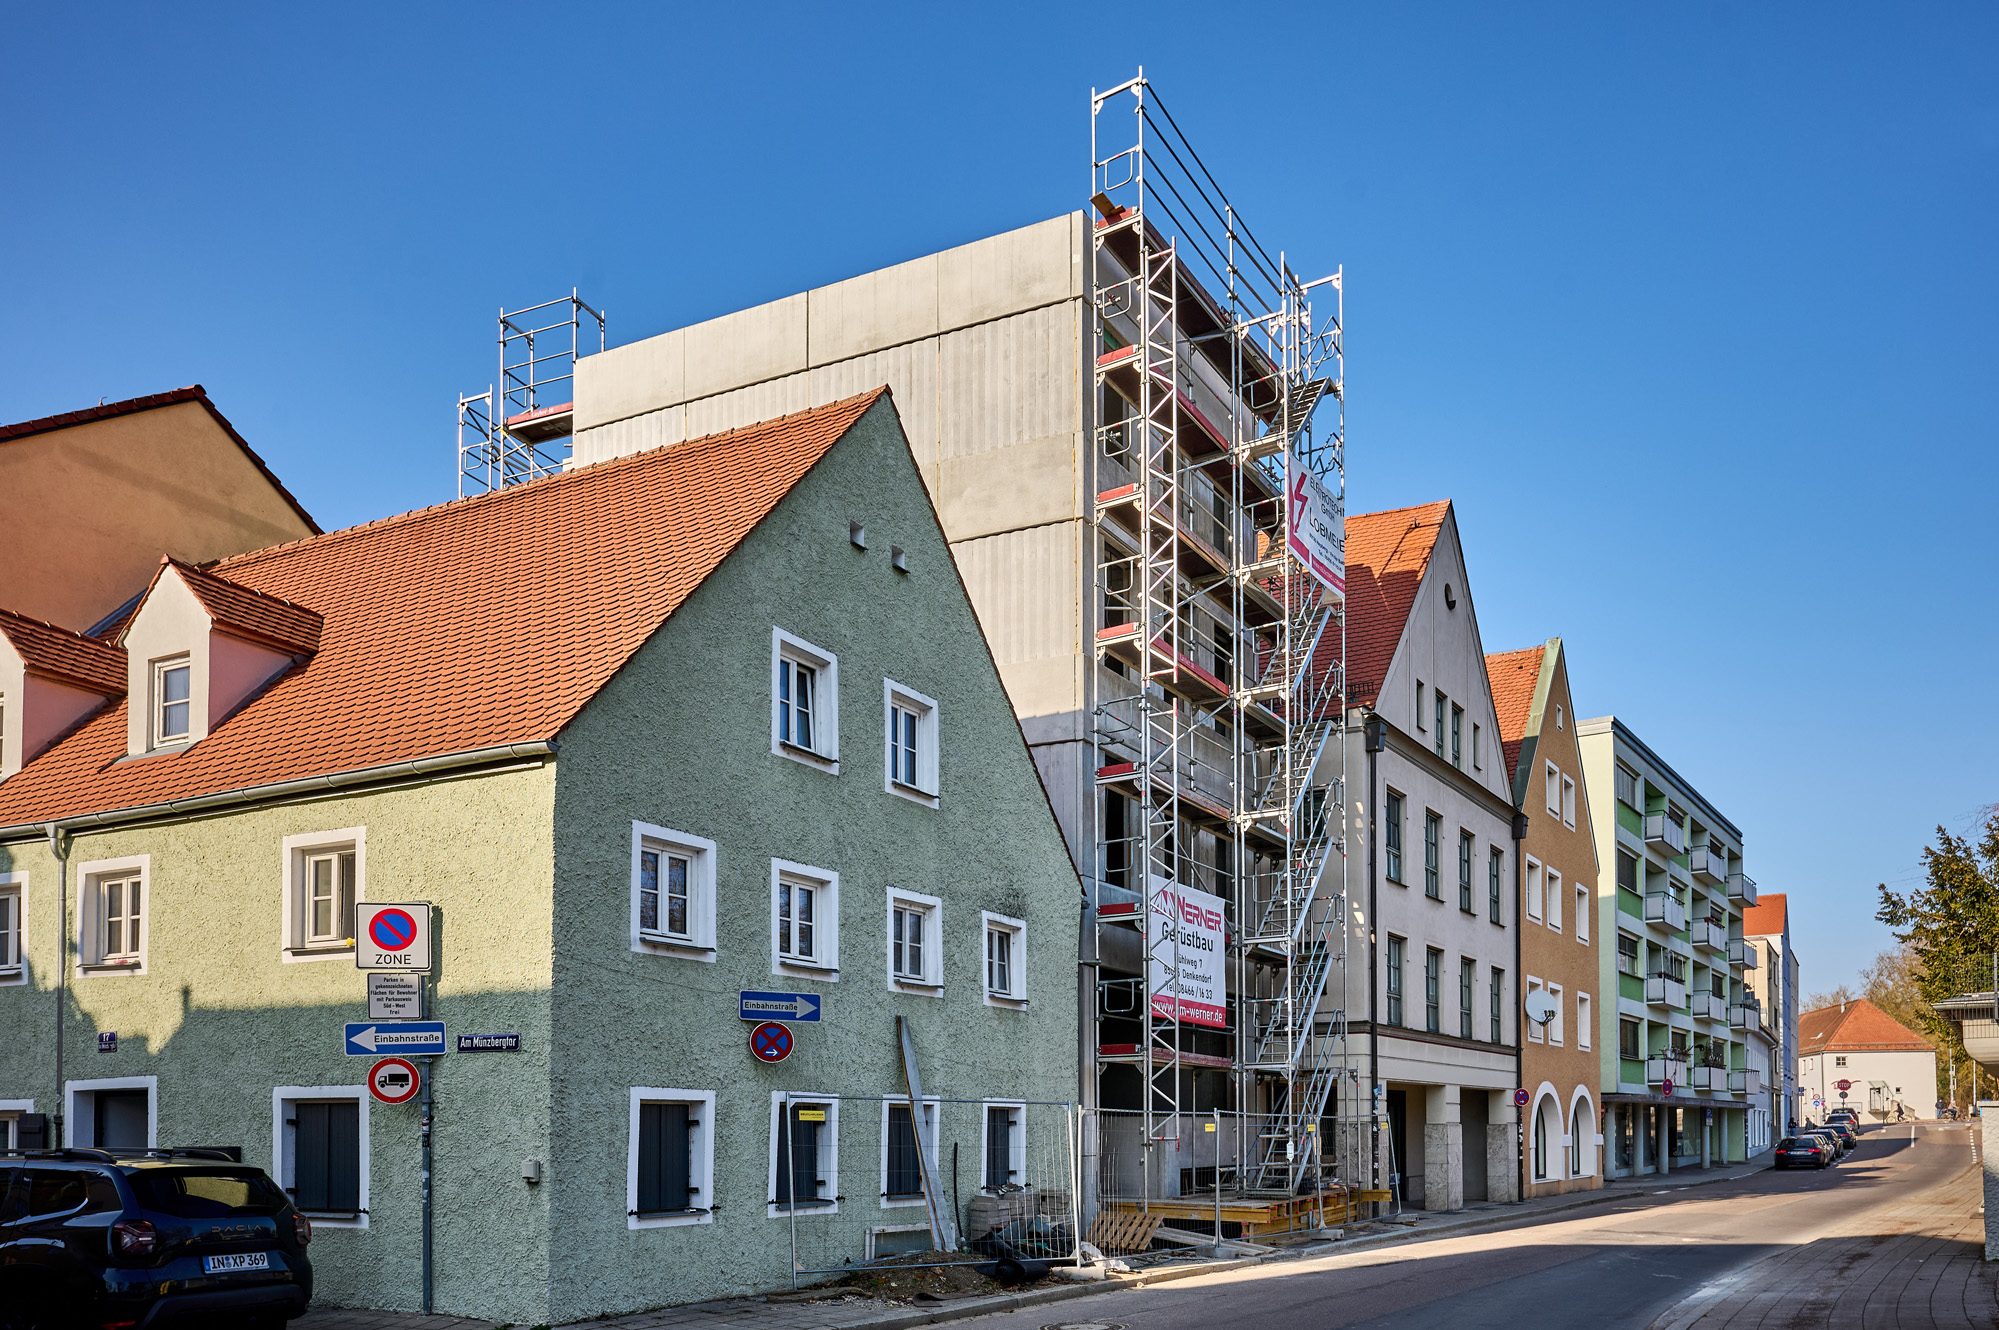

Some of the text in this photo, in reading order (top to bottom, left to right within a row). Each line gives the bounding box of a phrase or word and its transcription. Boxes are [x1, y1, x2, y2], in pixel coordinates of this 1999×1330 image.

[1162, 922, 1214, 952] Gerüstbau
[376, 954, 412, 964] ZONE
[1178, 954, 1198, 970] ühlweg
[1182, 968, 1212, 984] Denkendorf
[744, 1002, 798, 1011] Einbahnstraße
[1154, 1001, 1222, 1022] www.m-werner.de
[103, 1033, 110, 1041] 17
[374, 1034, 440, 1043] Einbahnstraße
[460, 1036, 516, 1049] Am Münzbergtor
[211, 1257, 225, 1269] IN
[232, 1255, 245, 1267] XP
[247, 1254, 265, 1266] 369
